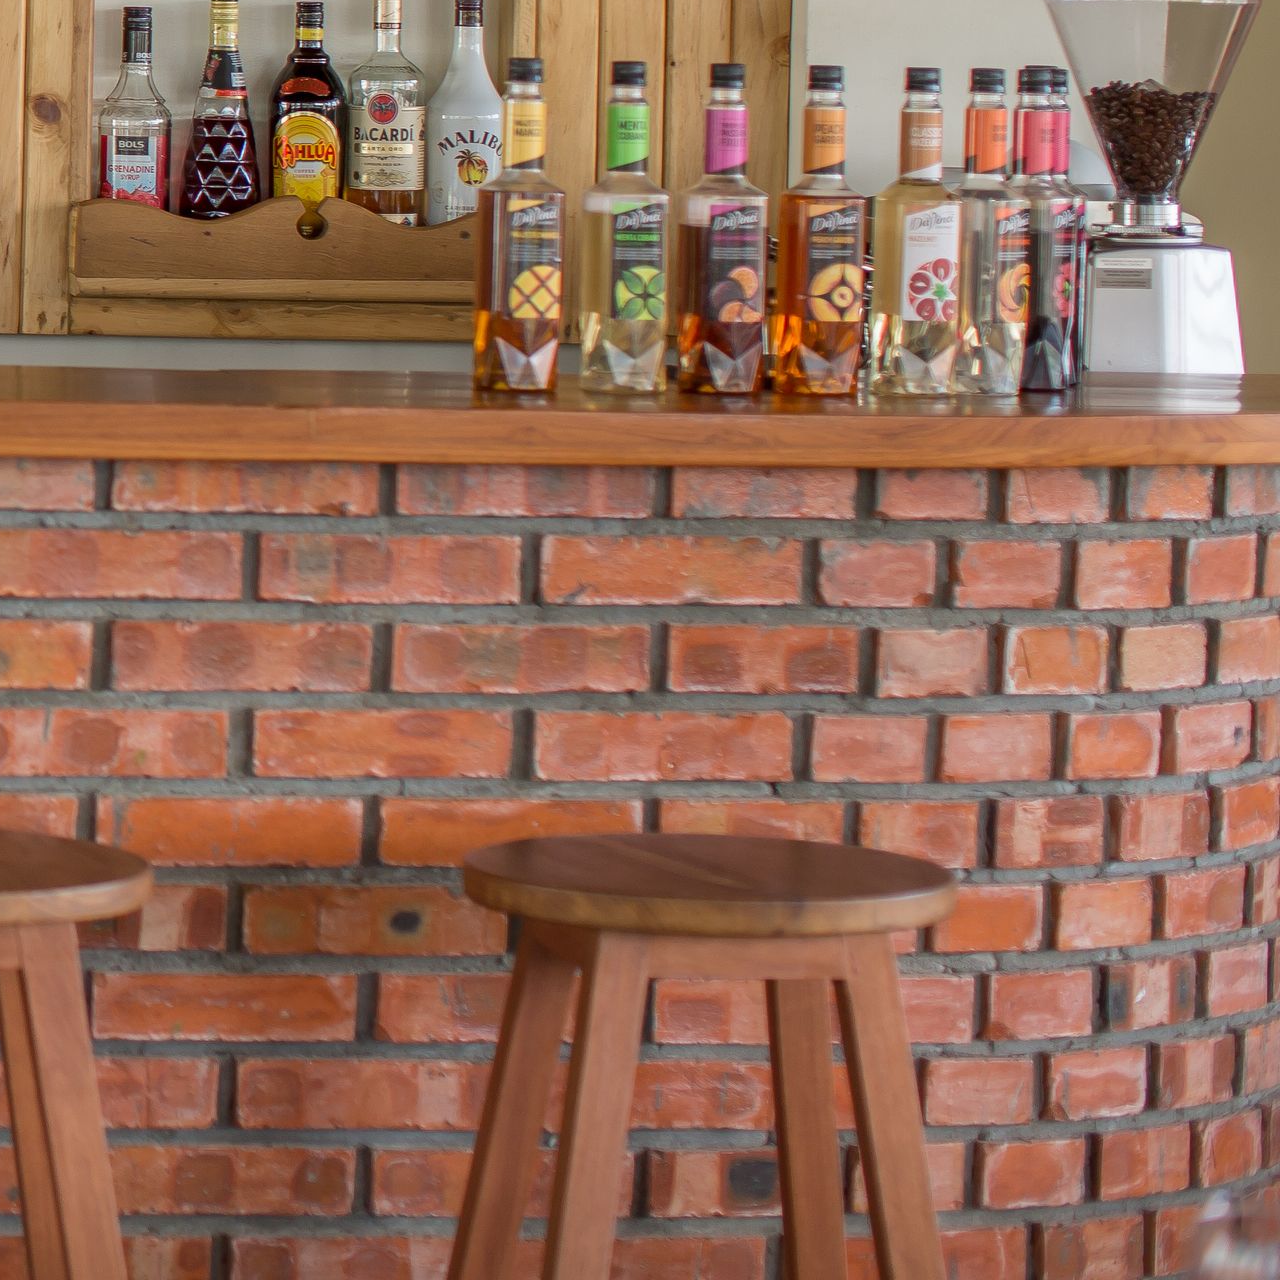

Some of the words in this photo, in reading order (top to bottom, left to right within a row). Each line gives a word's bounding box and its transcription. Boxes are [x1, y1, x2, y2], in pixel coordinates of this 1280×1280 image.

[354, 124, 414, 141] BACARDÍ
[118, 140, 145, 149] BOLS
[437, 129, 503, 157] MALIBU
[273, 135, 337, 170] KAHLÚA
[107, 164, 156, 174] GRENADINE
